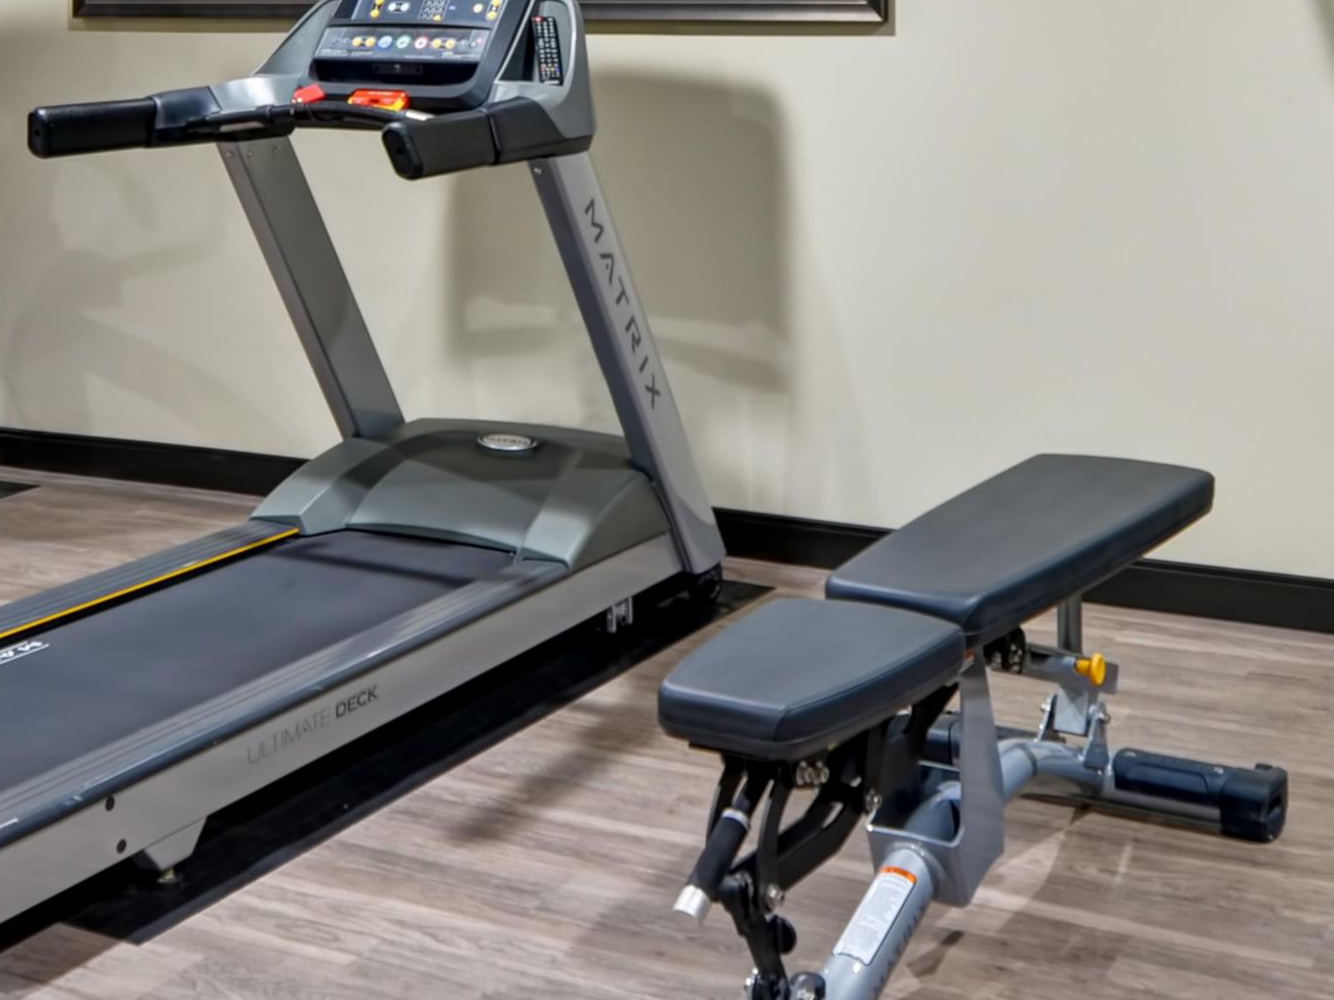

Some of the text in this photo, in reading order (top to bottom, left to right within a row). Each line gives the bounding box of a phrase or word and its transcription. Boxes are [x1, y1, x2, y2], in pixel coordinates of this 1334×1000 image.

[585, 198, 661, 411] MATRIX
[247, 684, 378, 764] ULTIMATE DECK
